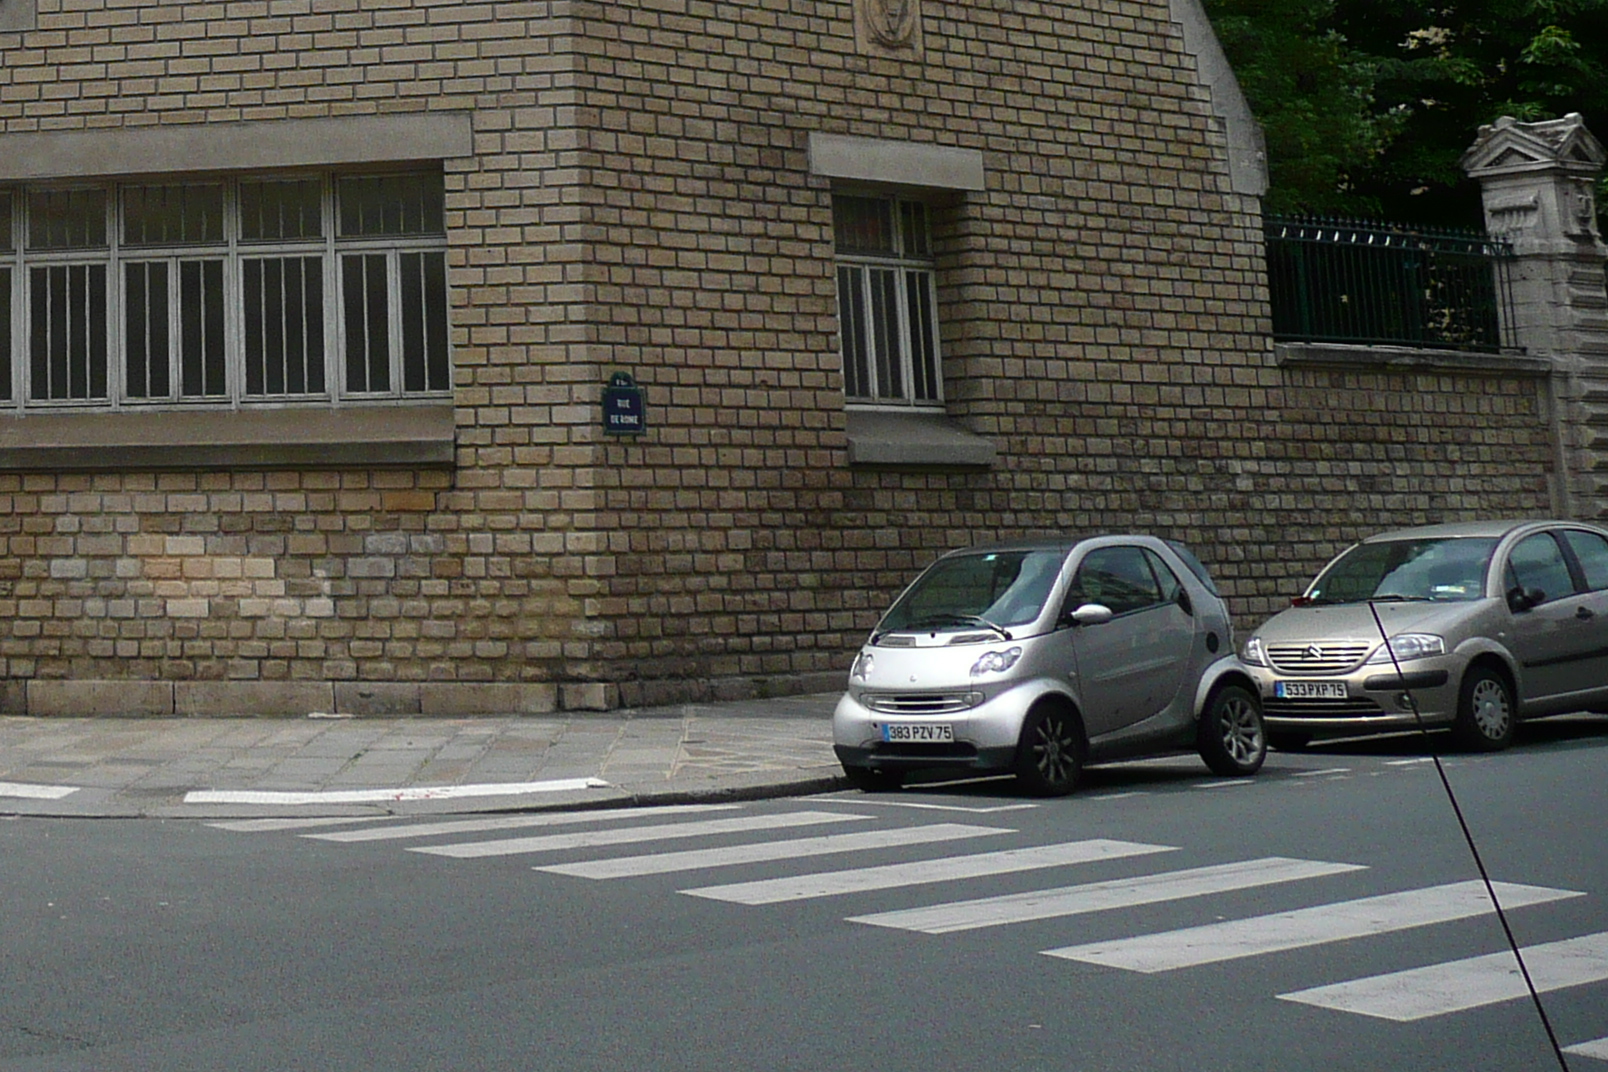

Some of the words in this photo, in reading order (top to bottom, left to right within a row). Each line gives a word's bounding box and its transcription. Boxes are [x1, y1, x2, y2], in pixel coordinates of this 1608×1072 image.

[1285, 683, 1306, 696] 533
[1307, 683, 1328, 696] PXP
[1329, 683, 1344, 697] 75
[889, 726, 911, 739] 383
[912, 726, 933, 739] PZV
[935, 726, 952, 739] 75
